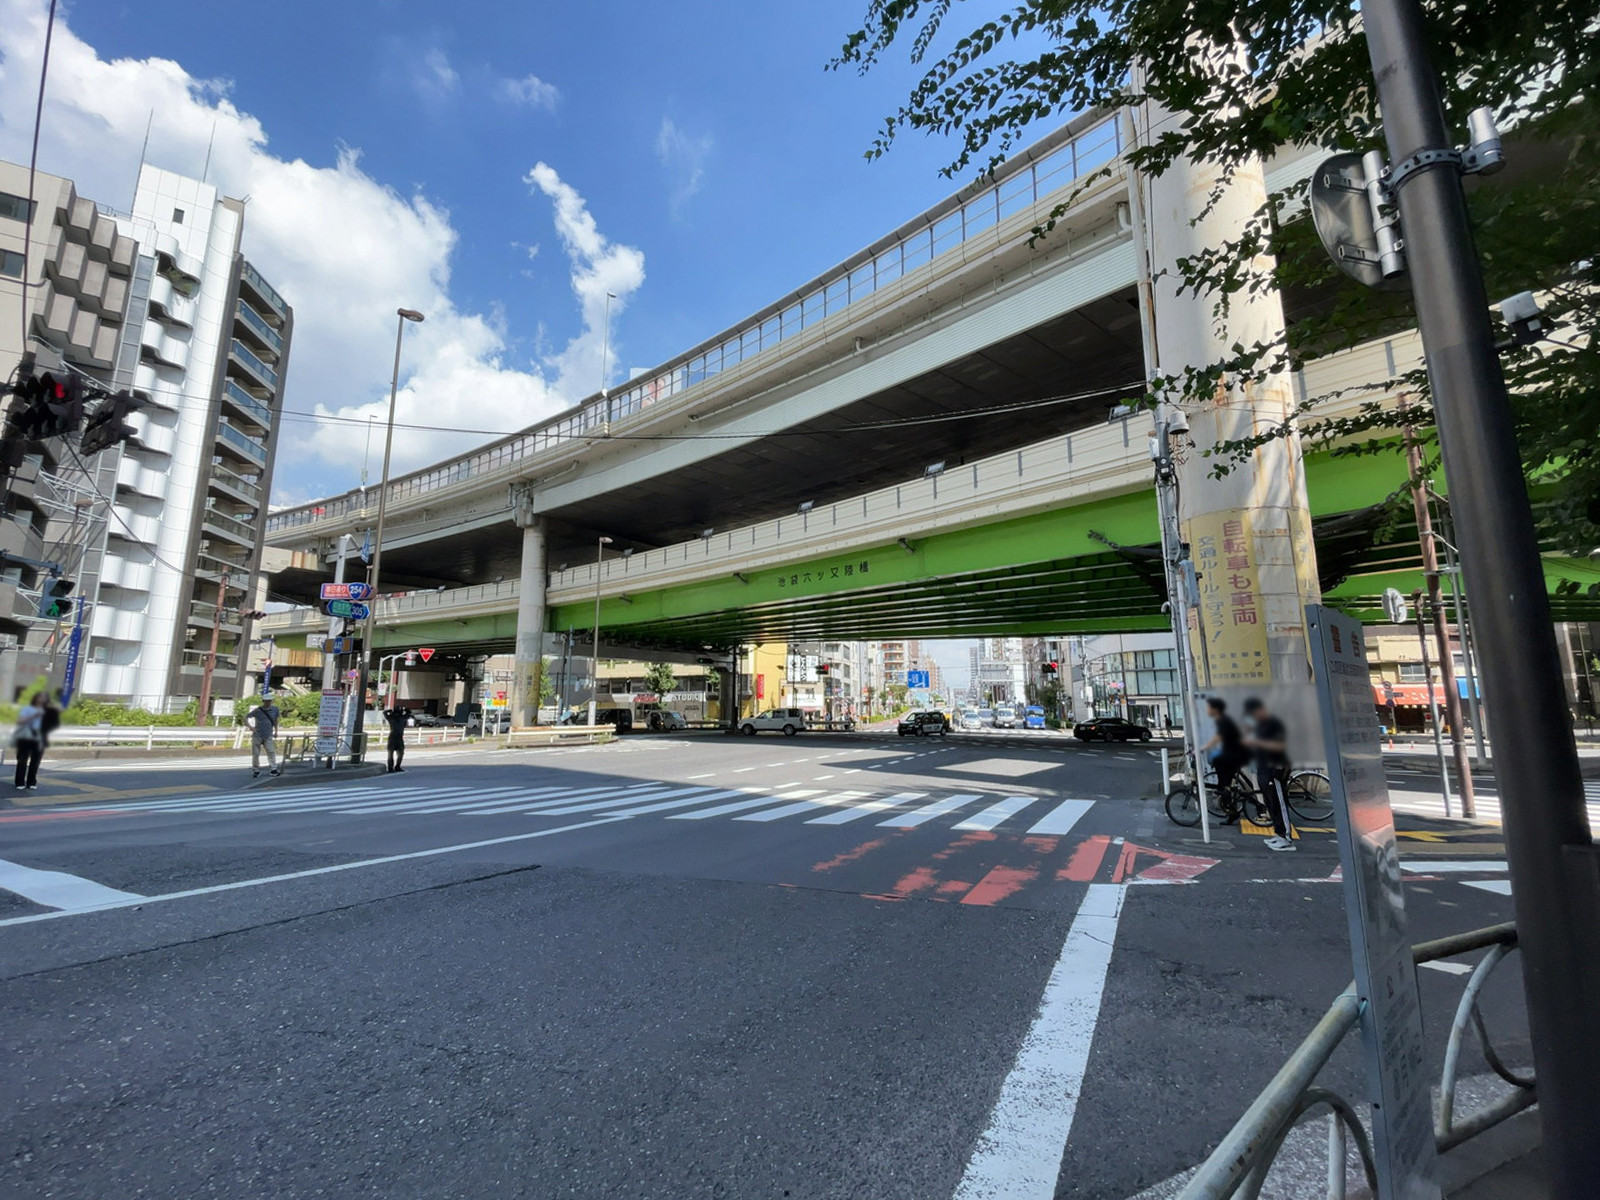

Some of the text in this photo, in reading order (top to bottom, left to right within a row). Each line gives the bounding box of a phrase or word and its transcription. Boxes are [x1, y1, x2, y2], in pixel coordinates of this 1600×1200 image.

[778, 560, 869, 588] 池袋六ツ又陸橋
[1222, 520, 1258, 626] 自転車も車両
[350, 585, 362, 594] 254
[352, 606, 363, 616] 305
[672, 692, 700, 702] STUDIO
